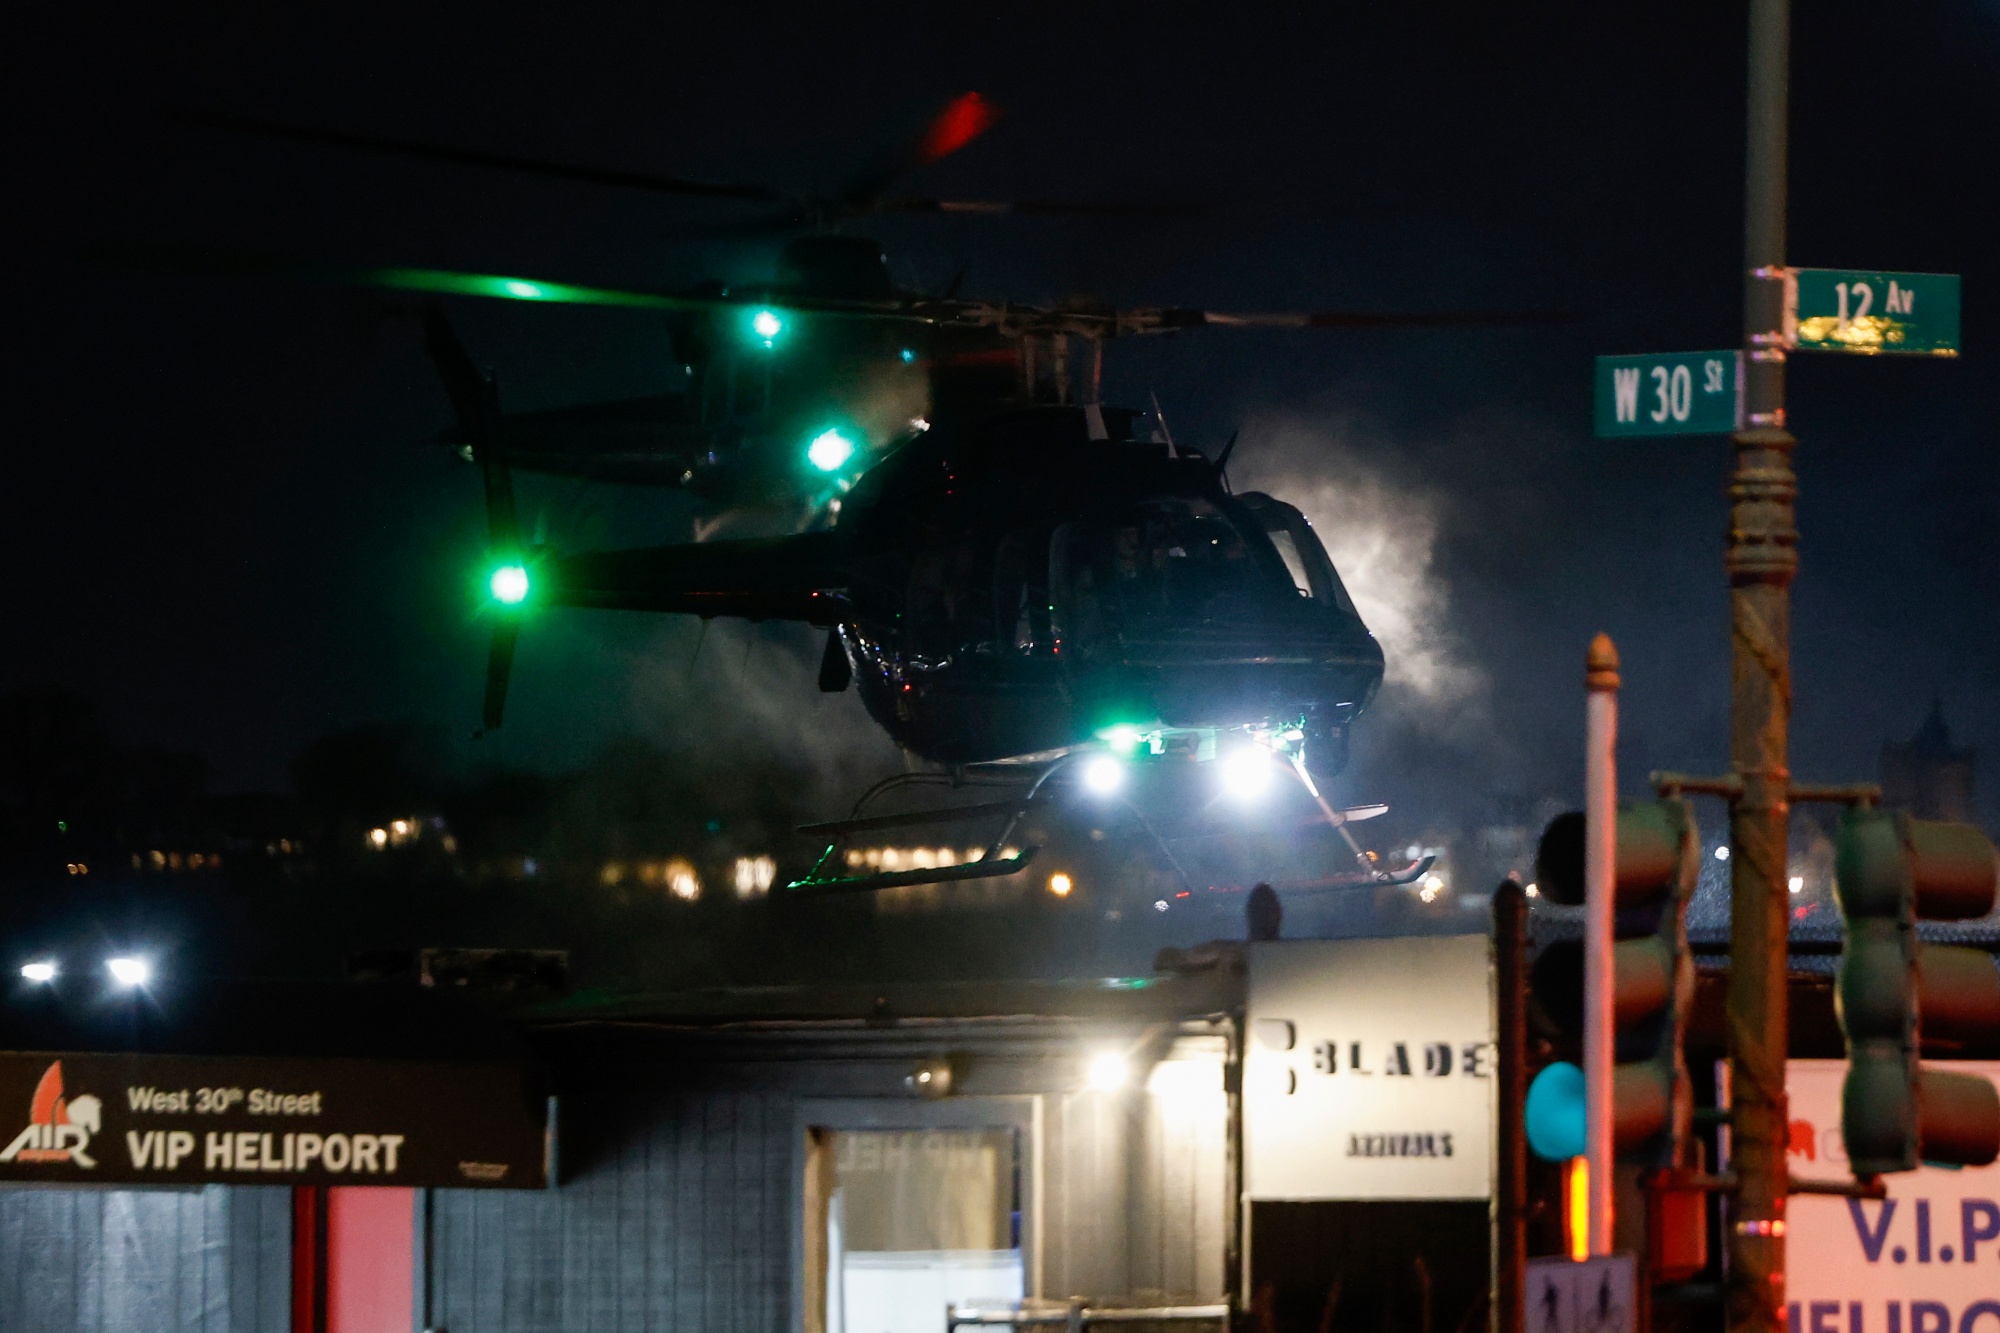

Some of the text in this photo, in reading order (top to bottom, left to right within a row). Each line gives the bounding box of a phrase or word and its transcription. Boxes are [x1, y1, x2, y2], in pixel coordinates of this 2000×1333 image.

[1836, 280, 1914, 332] 12 Av
[1613, 358, 1724, 423] W 30 St
[1313, 1041, 1494, 1078] BLADE
[127, 1086, 190, 1112] West
[248, 1087, 322, 1115] Street
[126, 1130, 404, 1174] VIP HELIPORT
[1845, 1198, 2000, 1265] V.I.P
